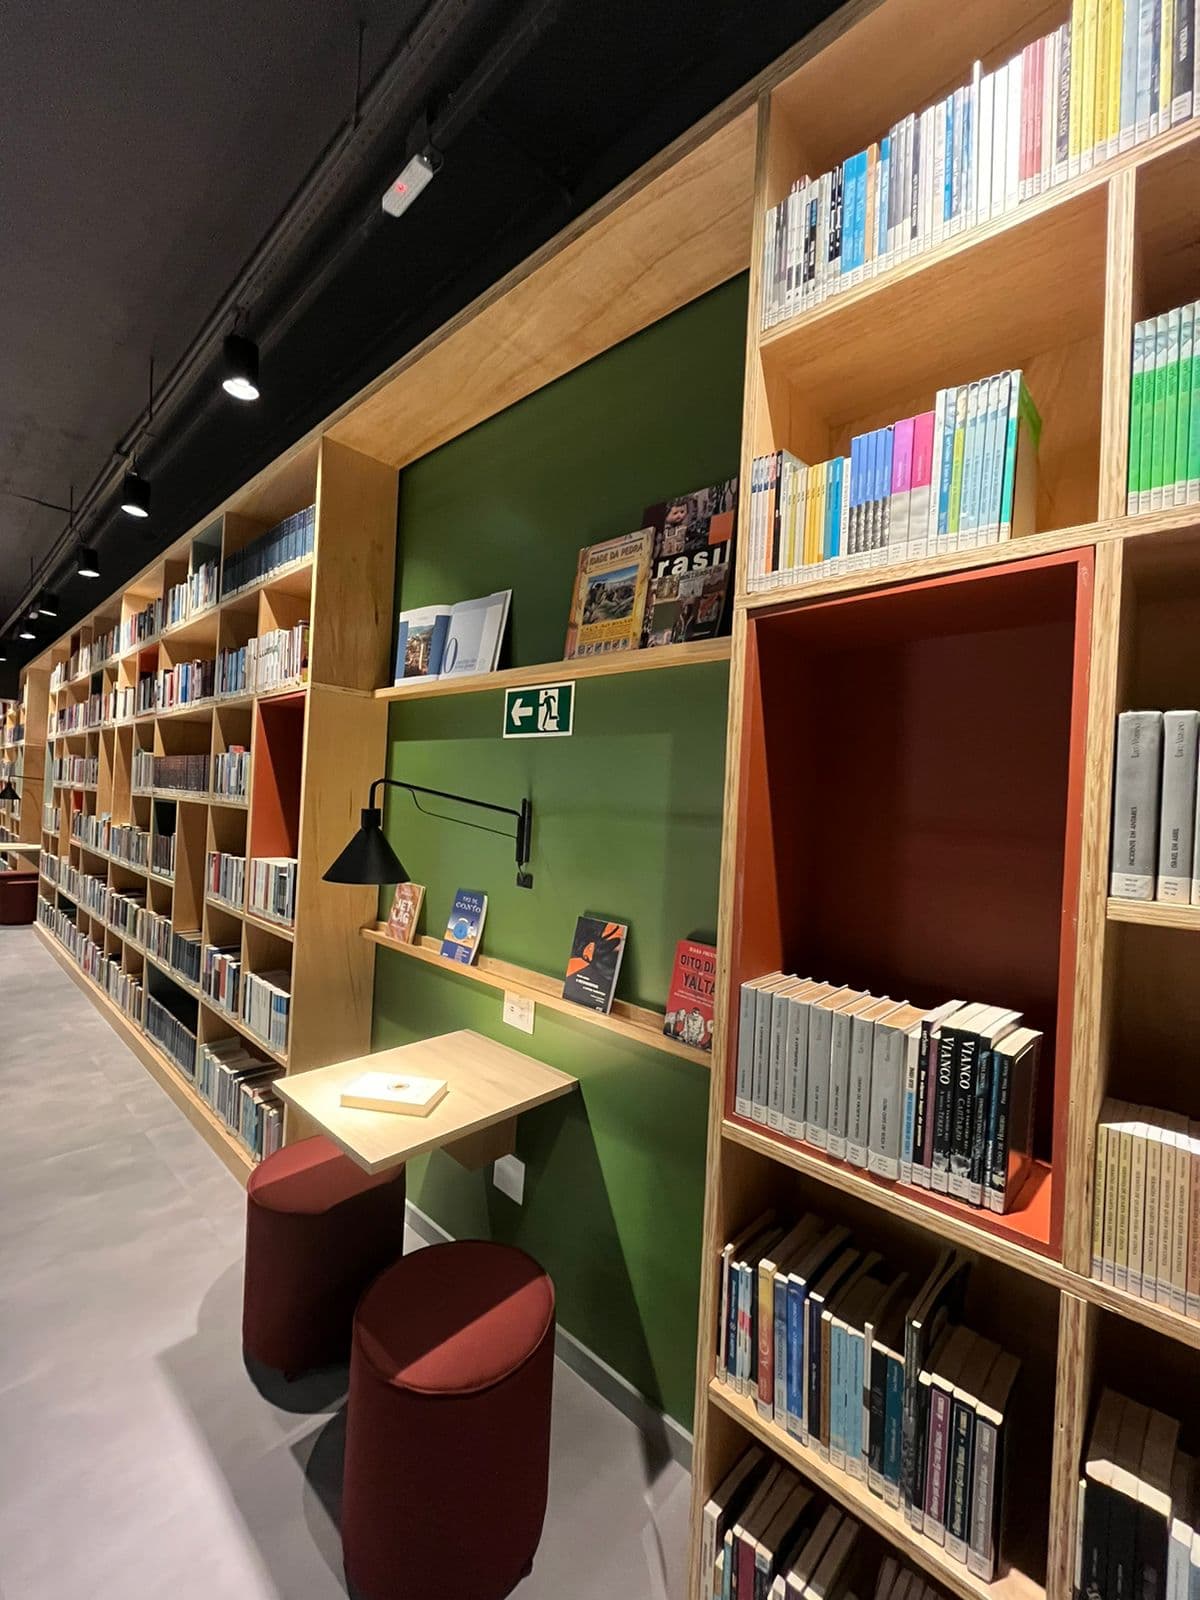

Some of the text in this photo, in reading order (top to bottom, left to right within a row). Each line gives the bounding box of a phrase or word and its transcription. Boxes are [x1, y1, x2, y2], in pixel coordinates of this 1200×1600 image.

[610, 551, 618, 560] DA
[651, 539, 730, 579] rasil
[395, 899, 413, 911] JET
[680, 955, 701, 969] OITO
[939, 1037, 954, 1084] VIANCO
[959, 1041, 975, 1089] VIANCO
